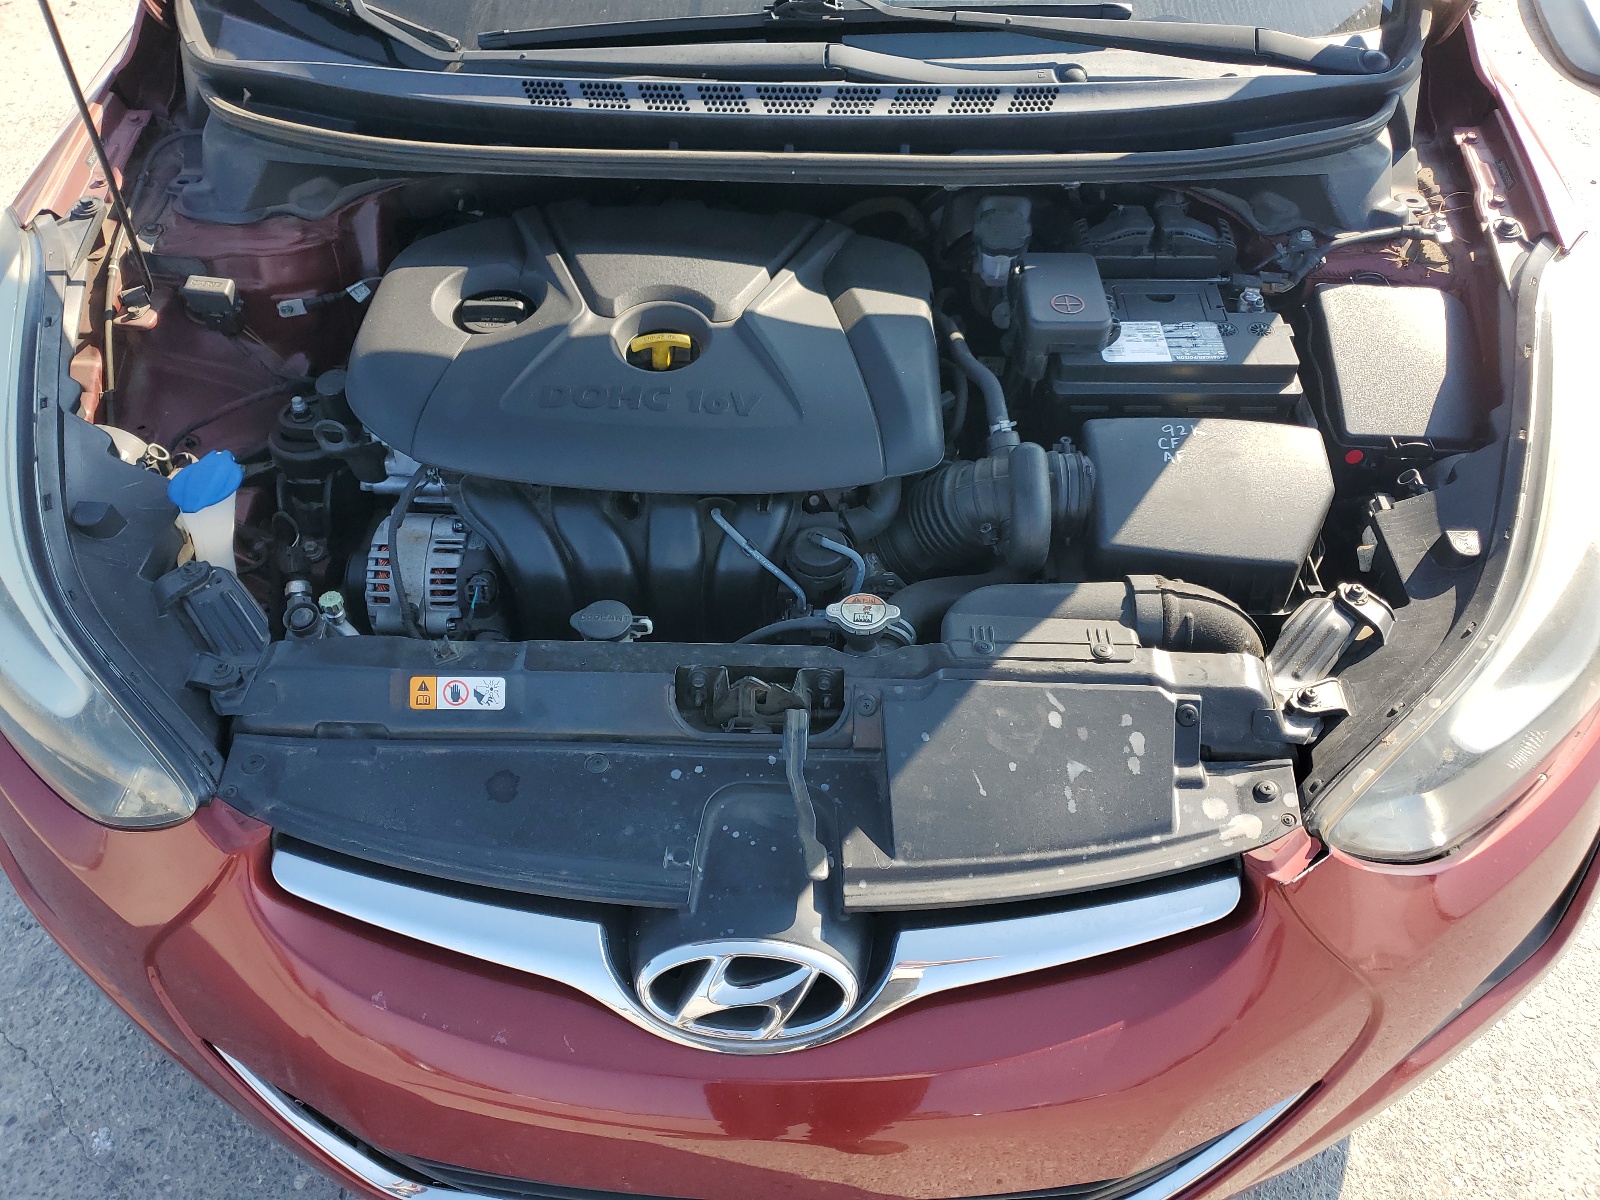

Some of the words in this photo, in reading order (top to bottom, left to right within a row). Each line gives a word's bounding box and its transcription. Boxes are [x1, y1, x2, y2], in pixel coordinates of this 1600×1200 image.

[537, 384, 673, 411] DOHC
[685, 388, 764, 416] 16V
[1157, 437, 1180, 450] CF
[580, 613, 630, 623] COOLANT
